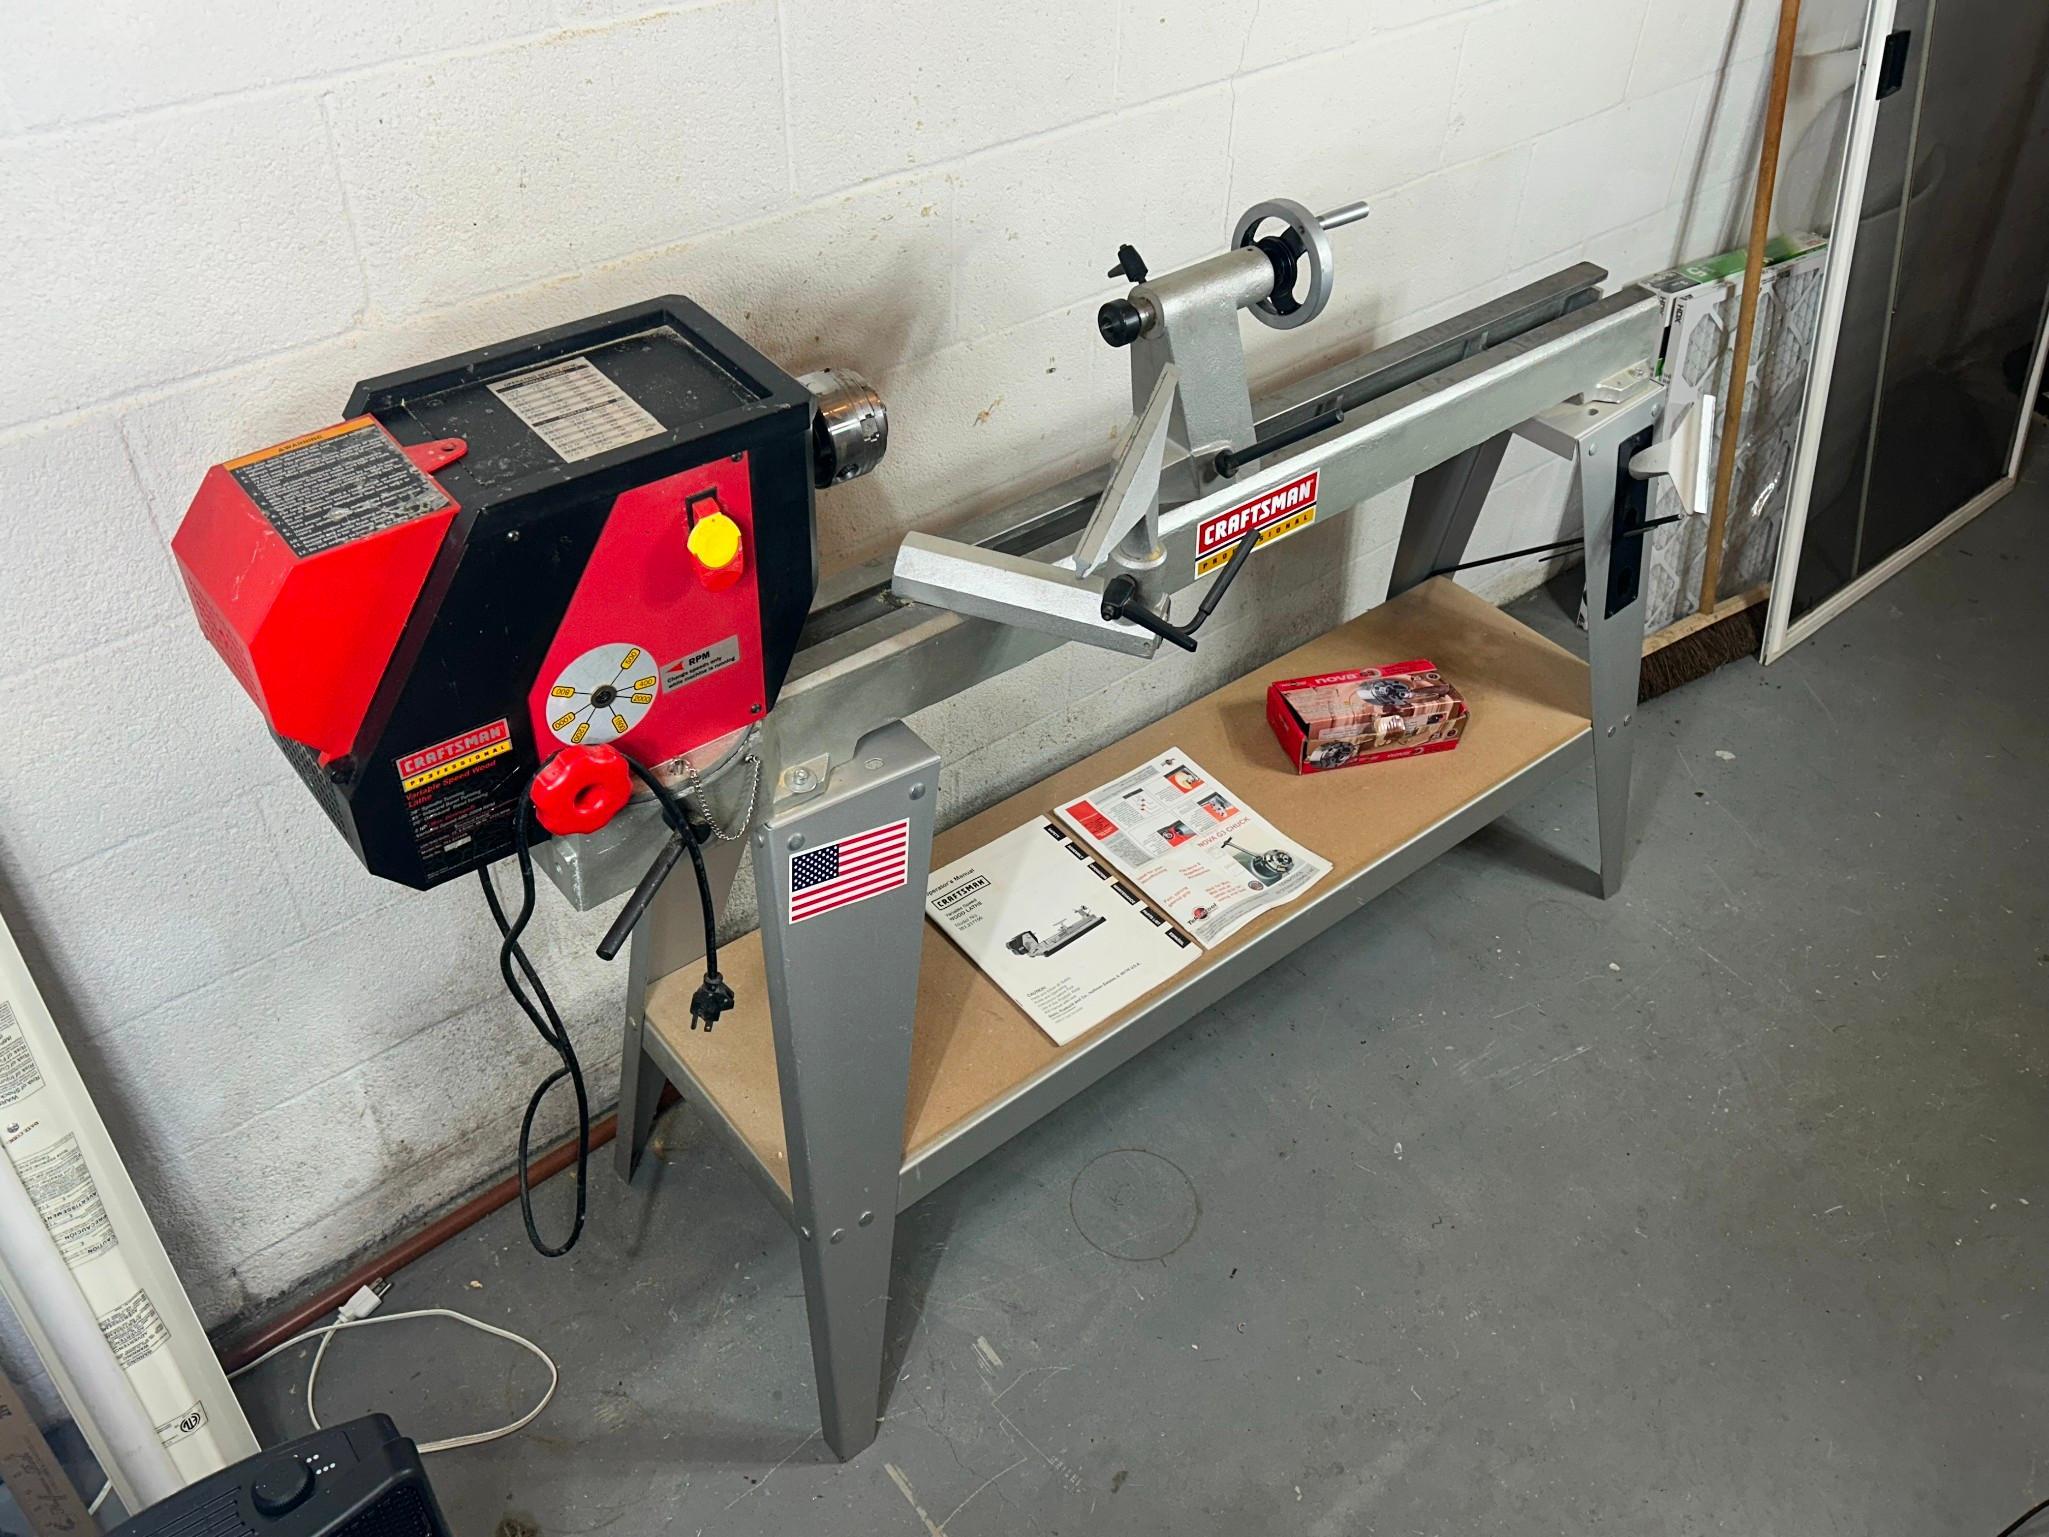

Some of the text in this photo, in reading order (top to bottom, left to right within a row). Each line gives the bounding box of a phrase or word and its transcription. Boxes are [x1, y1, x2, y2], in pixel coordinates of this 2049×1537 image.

[1675, 304, 1685, 324] HDX
[1204, 482, 1311, 545] CRAFTSMAN
[1203, 514, 1307, 569] PROSIONAL
[667, 656, 722, 683] Change speeds only
[689, 651, 710, 666] RPM
[639, 679, 653, 687] 400
[668, 679, 685, 688] while
[715, 656, 736, 671] running
[1315, 674, 1357, 684] nova
[404, 728, 501, 772] CRAFTSMAN
[410, 745, 505, 786] PROFESSIONAL
[406, 760, 497, 801] Variable Speed Wood
[408, 794, 433, 809] Lathe
[1198, 834, 1217, 848] NOVA
[1227, 816, 1250, 834] CHUCK
[926, 868, 975, 896] perator's Manual
[937, 879, 985, 907] CRAFTSMAN
[950, 901, 982, 921] WOOD LATHE
[27, 1076, 41, 1085] Risk
[24, 1121, 40, 1134] DATE
[64, 1214, 108, 1240] PRECAUCIÓN
[87, 1235, 116, 1254] CAUTION
